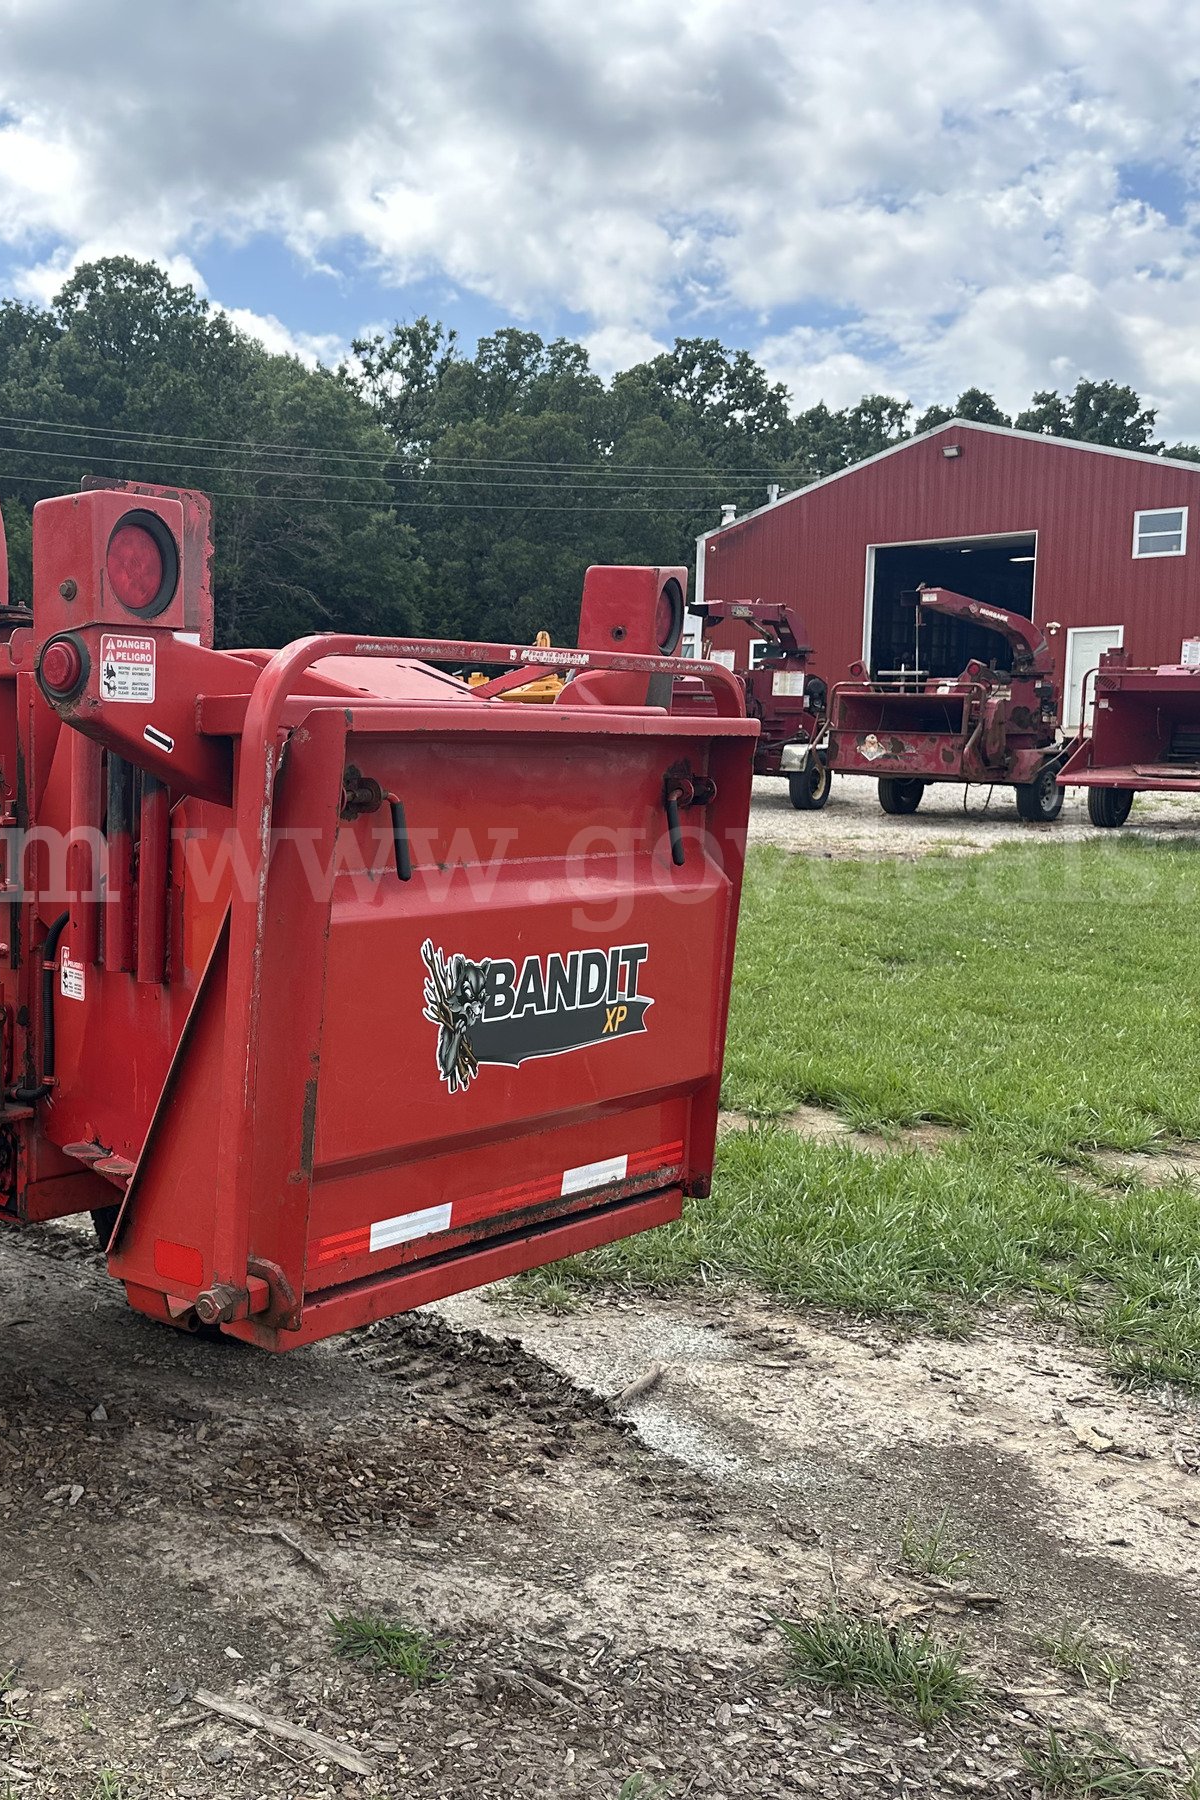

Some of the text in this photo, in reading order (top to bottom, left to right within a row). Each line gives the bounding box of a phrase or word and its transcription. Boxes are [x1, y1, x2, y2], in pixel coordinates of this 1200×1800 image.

[116, 640, 151, 650] DANGER
[116, 652, 152, 662] PELIGRO
[482, 943, 649, 1022] BANDIT
[602, 1005, 627, 1033] XP
